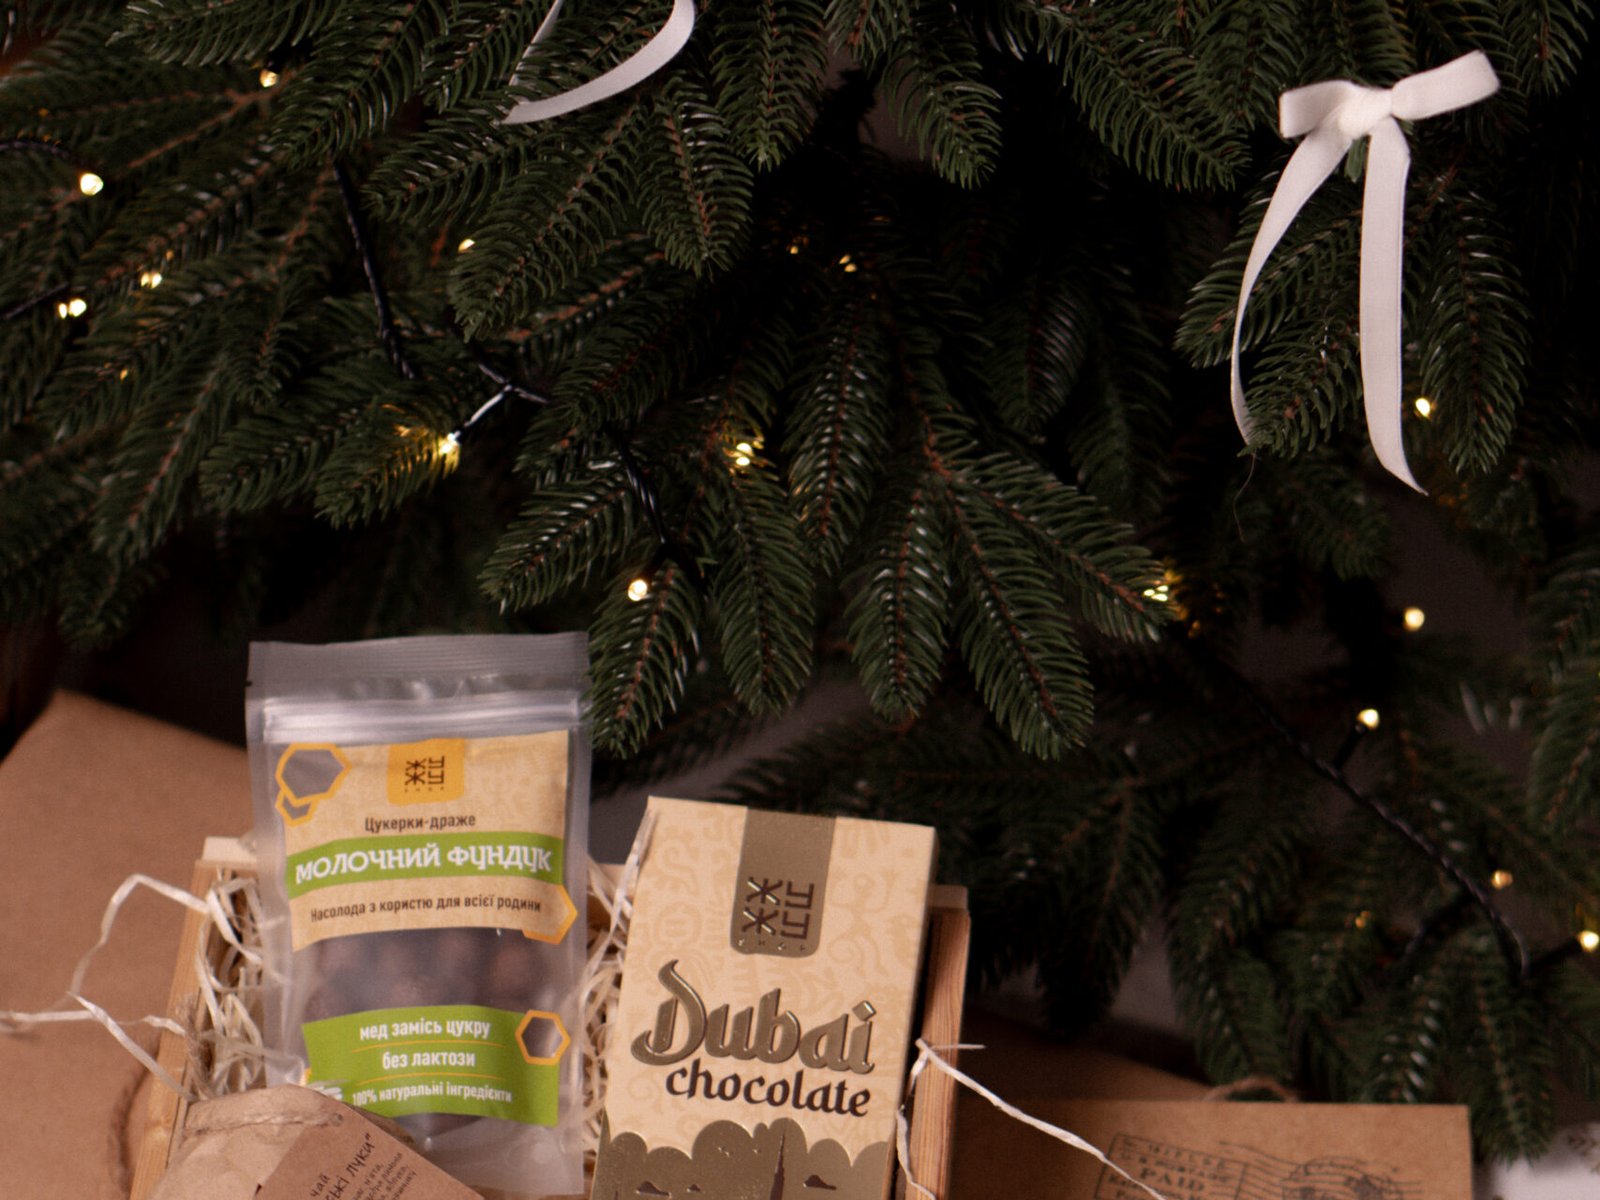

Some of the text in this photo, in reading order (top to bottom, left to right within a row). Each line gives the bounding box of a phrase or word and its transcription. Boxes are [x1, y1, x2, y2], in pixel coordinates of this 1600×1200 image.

[365, 814, 476, 834] Цукерки-драже
[295, 843, 552, 885] МОЛОЧНИЙ ФУНДУК
[310, 893, 541, 923] Насолода з користю для всієї родини
[360, 1017, 491, 1041] мед замісь цукру
[630, 959, 877, 1075] Dubai
[382, 1051, 476, 1070] без лактози
[352, 1081, 513, 1107] 100% натуральні інгредієнти
[665, 1057, 871, 1118] chocolate
[310, 1173, 331, 1198] чай
[1140, 1167, 1205, 1191] PAID
